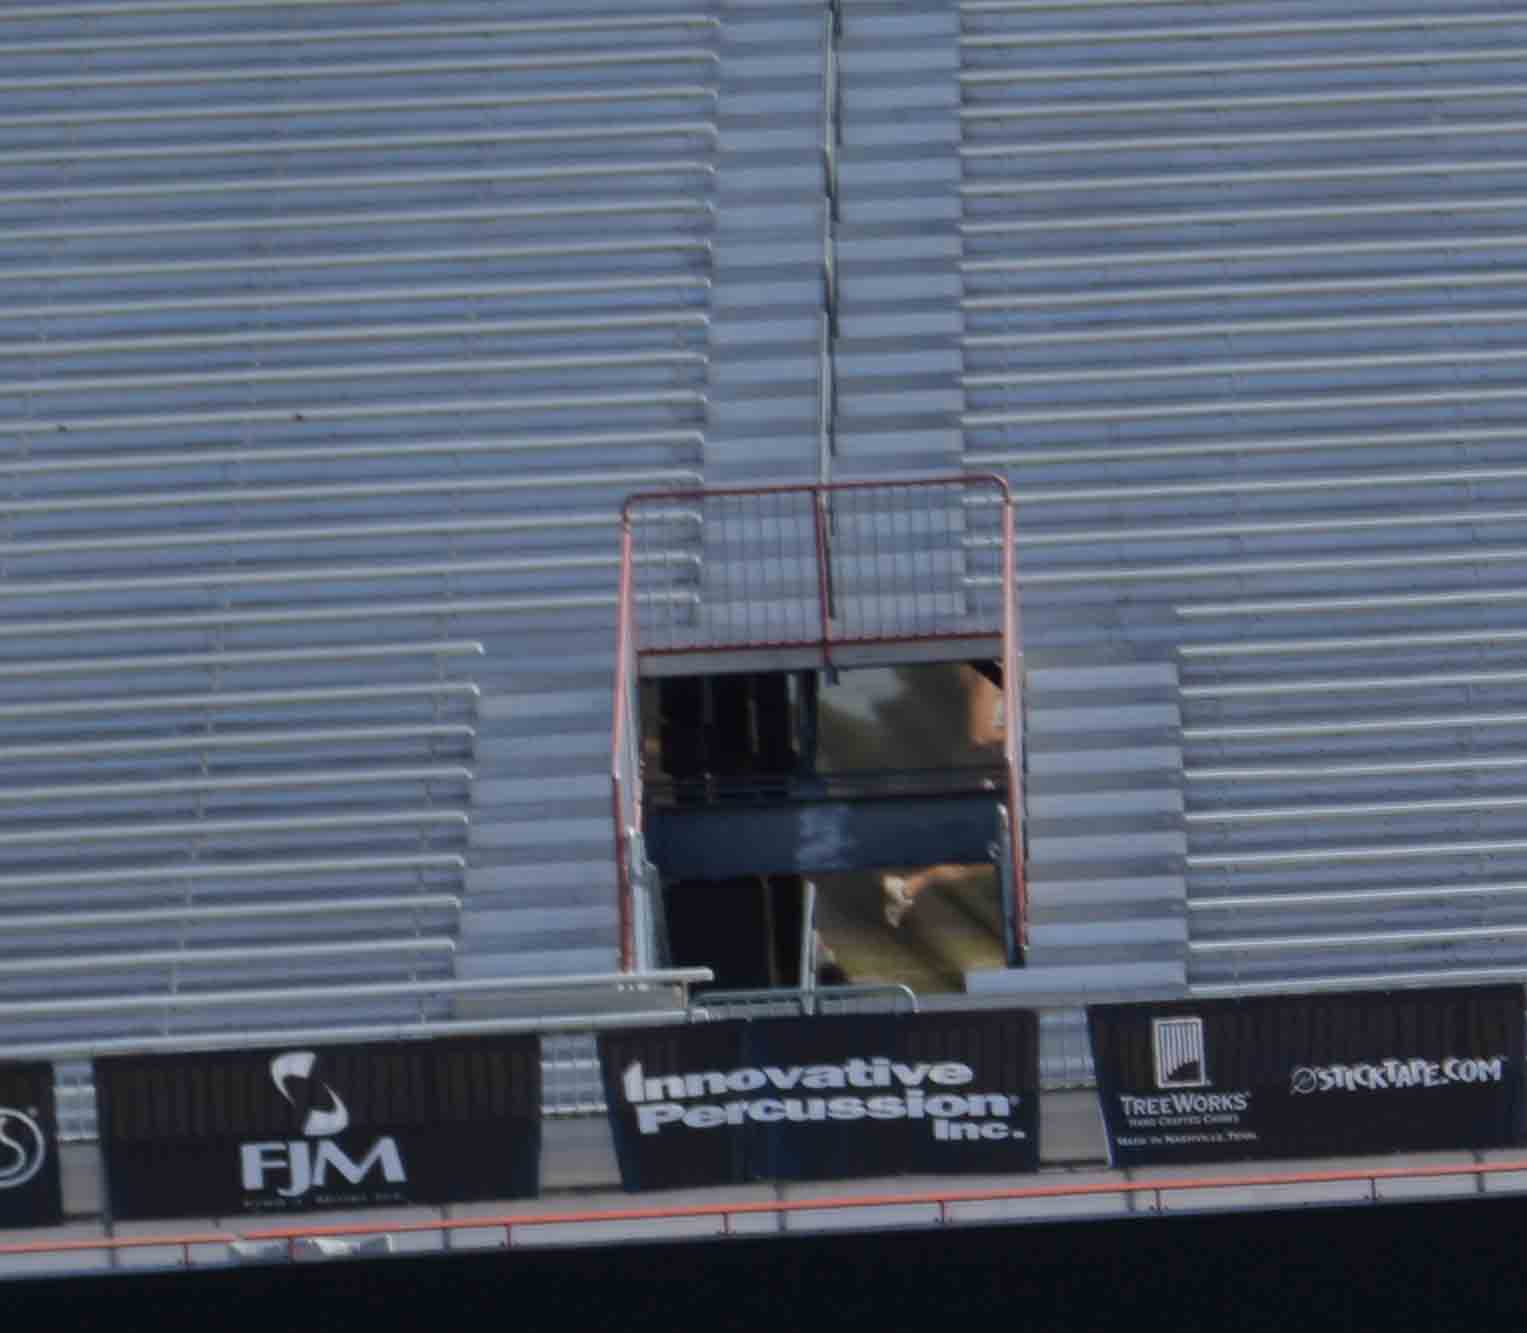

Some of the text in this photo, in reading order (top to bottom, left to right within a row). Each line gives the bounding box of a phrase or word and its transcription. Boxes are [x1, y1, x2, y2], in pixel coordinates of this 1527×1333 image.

[622, 1056, 975, 1103] Innovative
[637, 1087, 1012, 1134] Percussion
[932, 1117, 1026, 1141] Inc.
[239, 1135, 407, 1198] FJM
